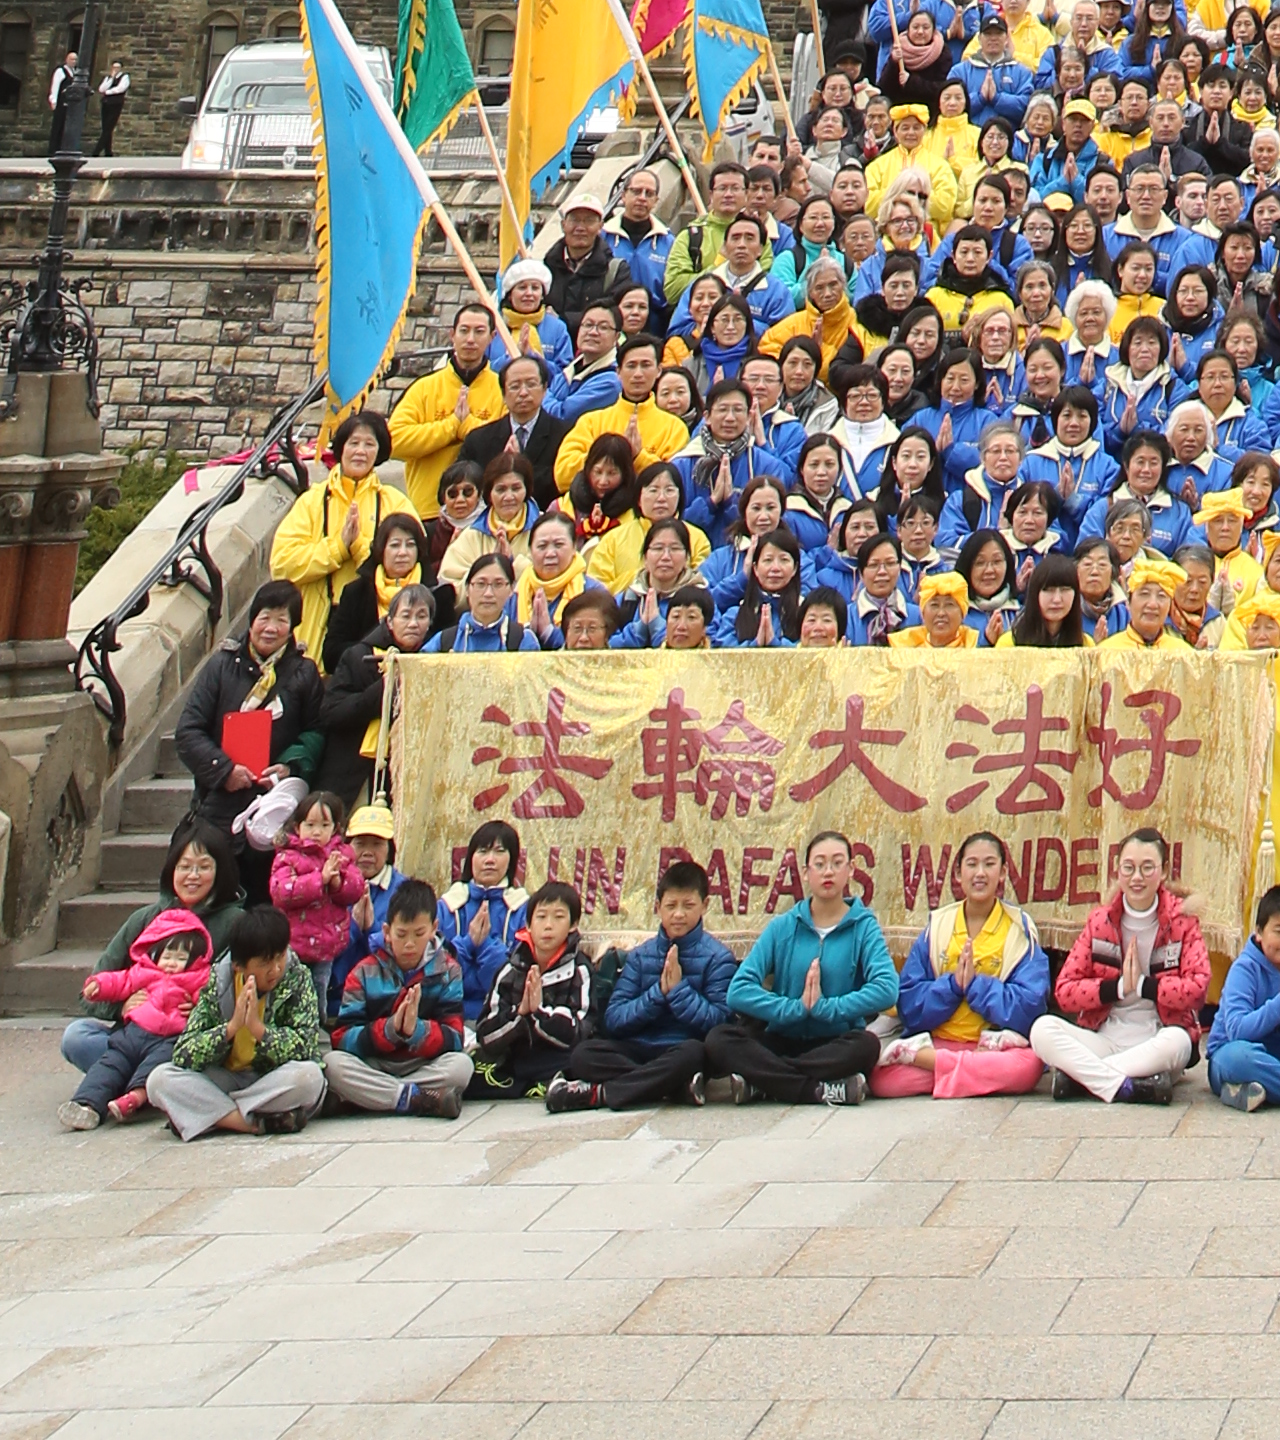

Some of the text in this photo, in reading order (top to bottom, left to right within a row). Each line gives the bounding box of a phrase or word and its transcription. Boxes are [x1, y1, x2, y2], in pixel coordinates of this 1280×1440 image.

[471, 682, 1200, 823] 法輪大法好
[451, 846, 626, 914] FLUN
[654, 845, 805, 914] DAFA
